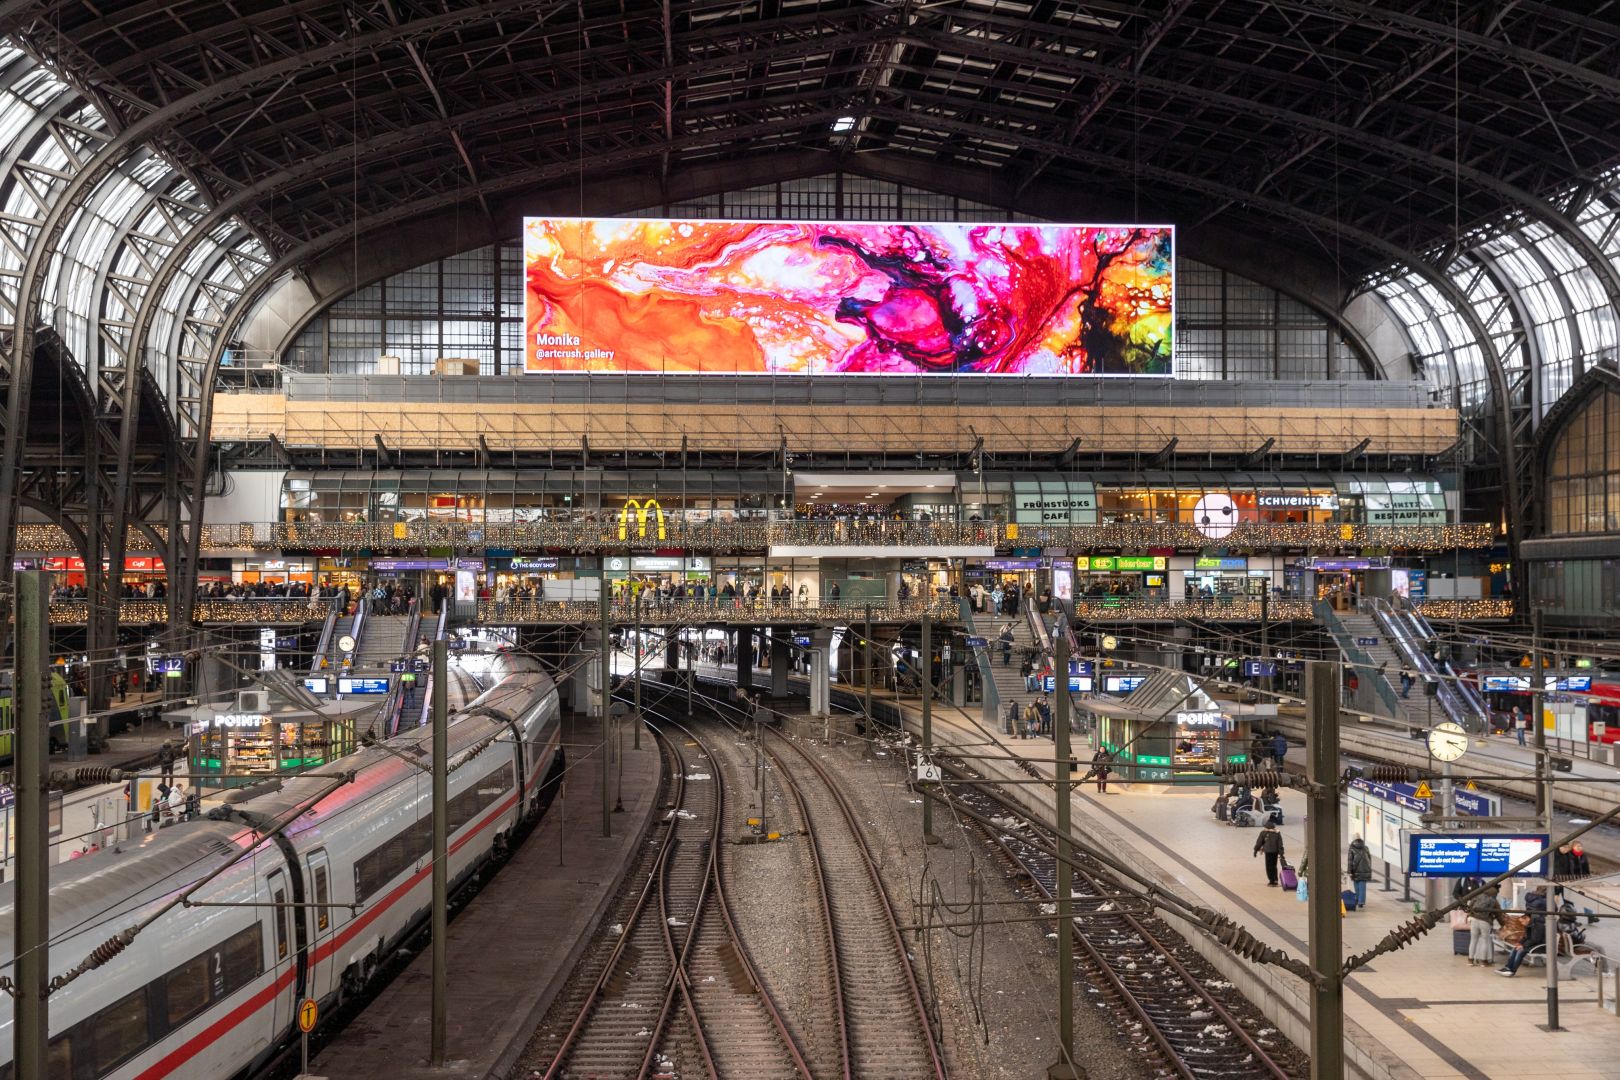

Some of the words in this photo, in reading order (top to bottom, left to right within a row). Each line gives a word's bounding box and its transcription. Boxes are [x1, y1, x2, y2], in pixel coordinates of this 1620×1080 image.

[536, 333, 580, 346] Monika
[536, 348, 615, 360] @artcrush.gallery
[1023, 500, 1090, 509] FRÜHSTÜCKS
[1043, 512, 1070, 520] CAFÉ
[1375, 511, 1440, 520] RESTAURANT
[152, 660, 160, 670] E
[167, 659, 182, 670] 12
[1078, 662, 1086, 673] E
[1252, 663, 1260, 674] E
[215, 714, 262, 727] POINT
[926, 767, 933, 778] 6
[214, 951, 221, 974] 2
